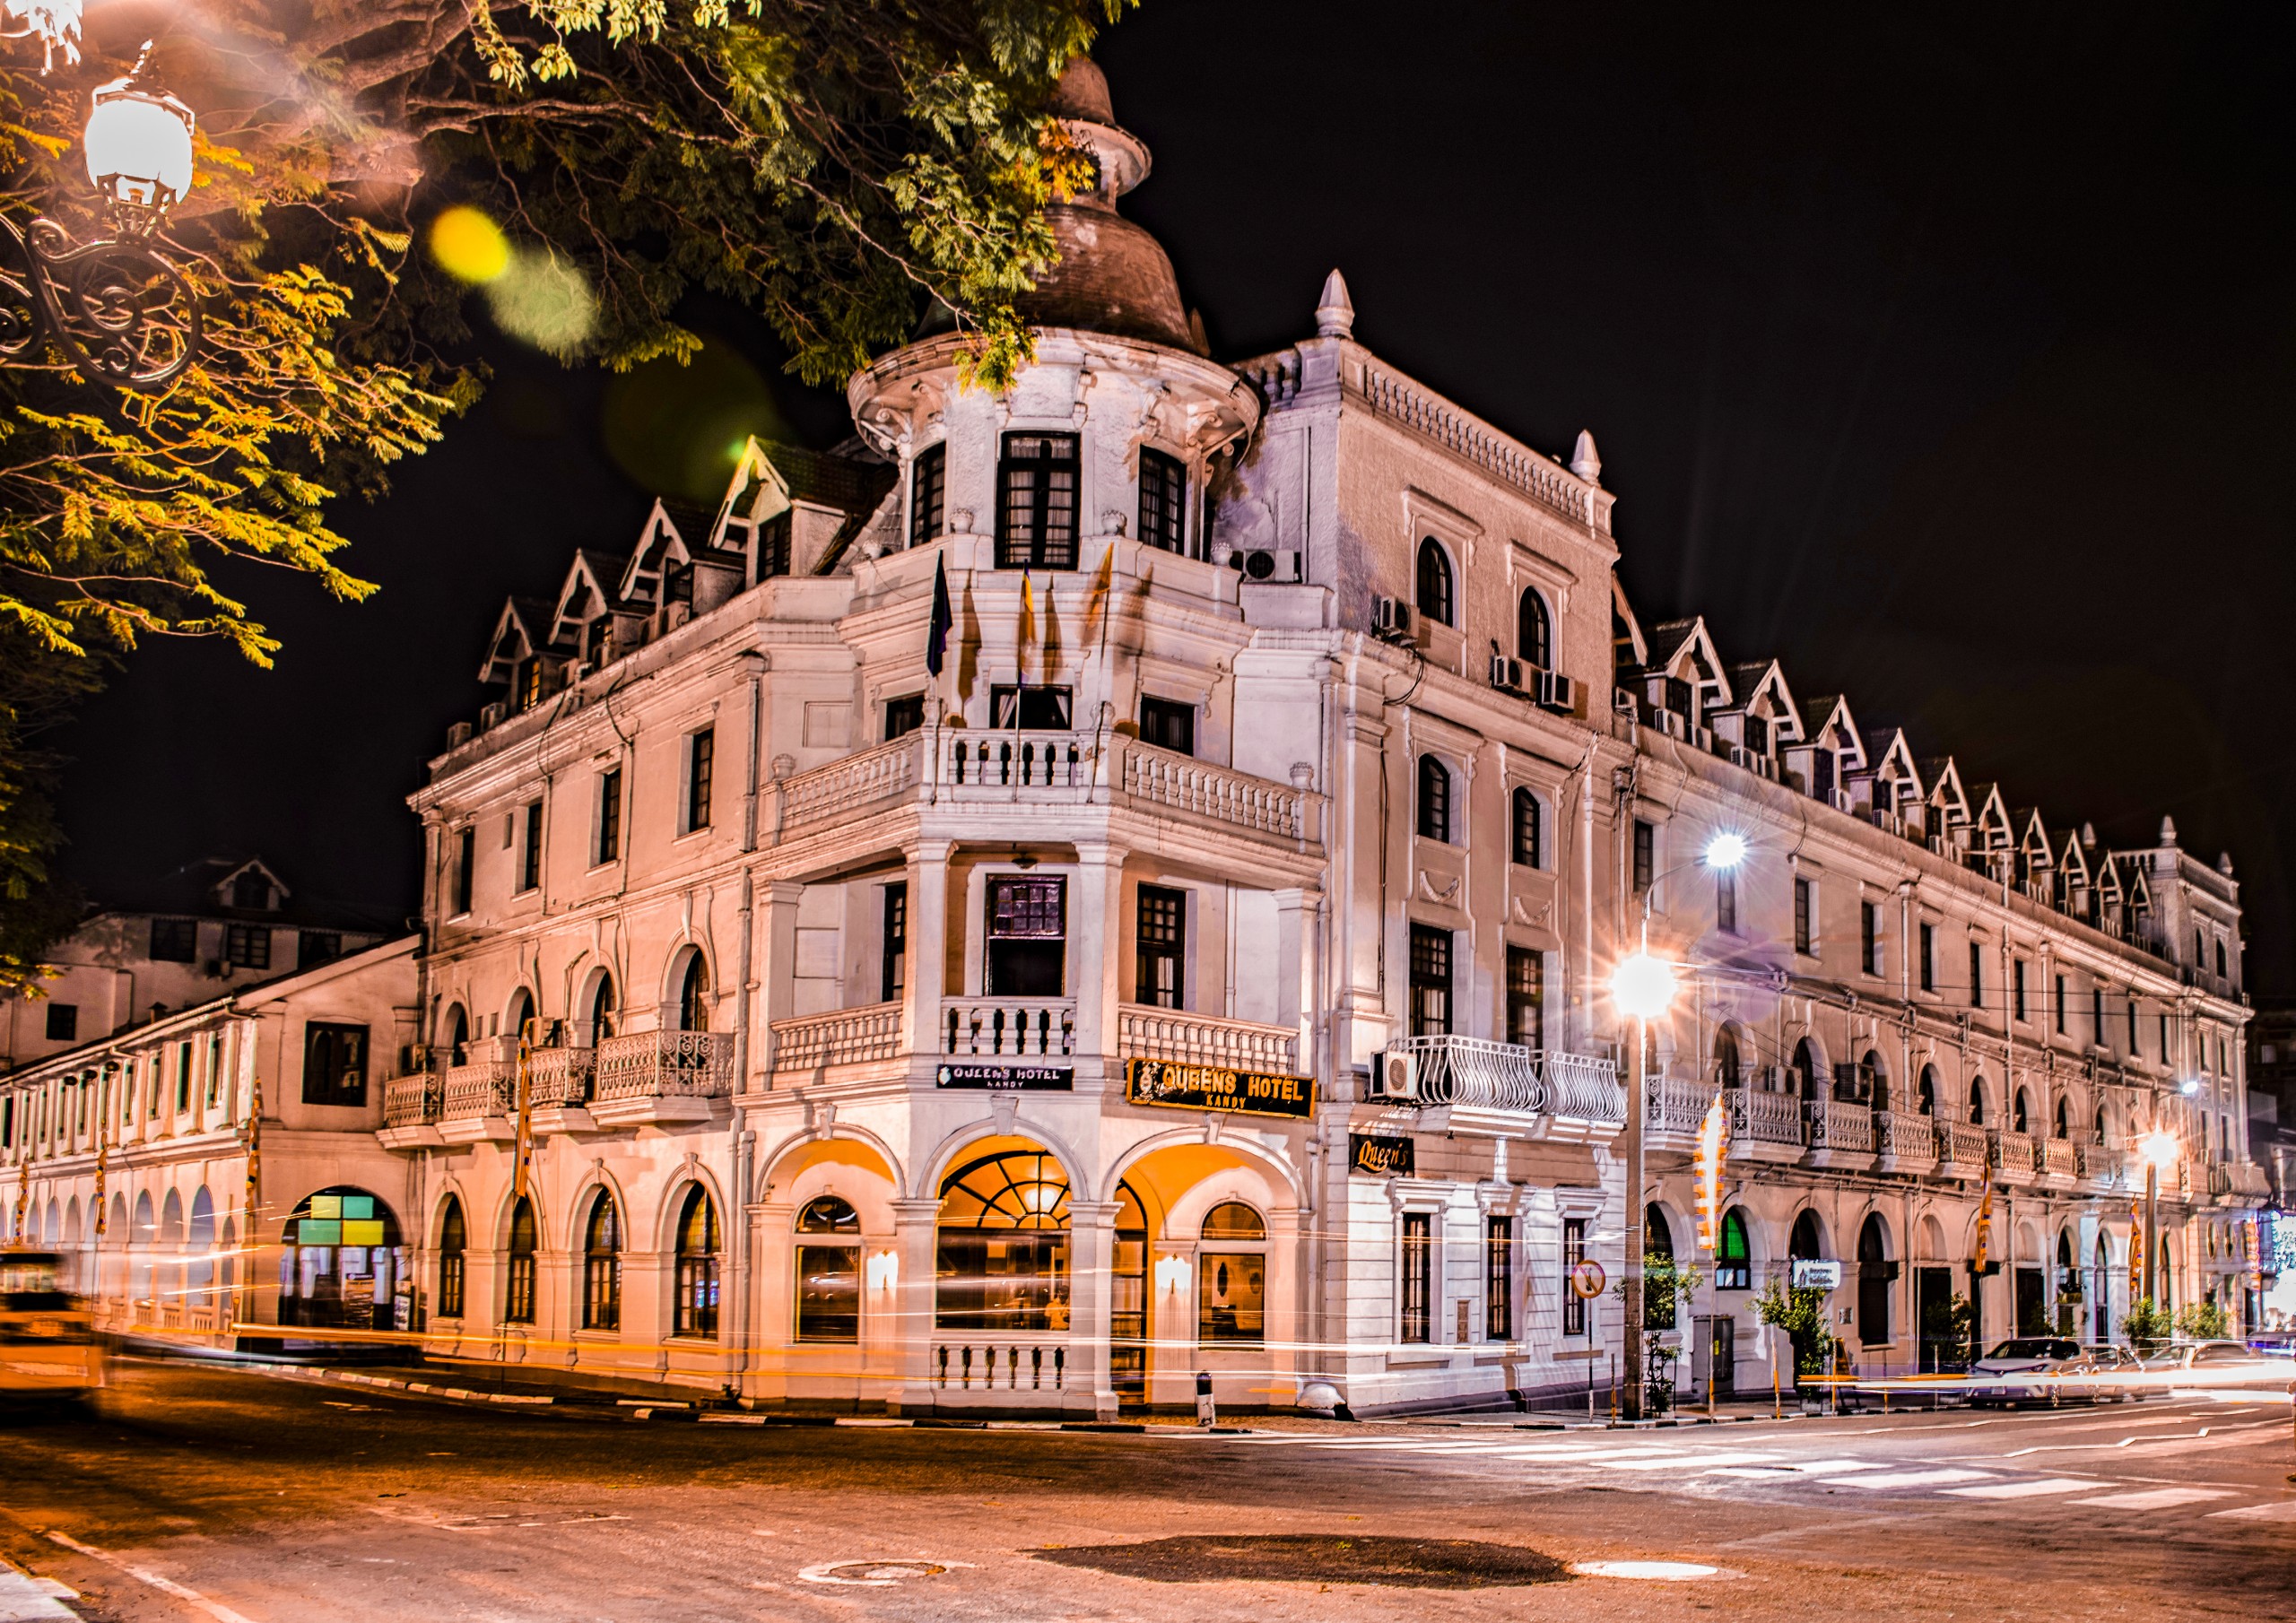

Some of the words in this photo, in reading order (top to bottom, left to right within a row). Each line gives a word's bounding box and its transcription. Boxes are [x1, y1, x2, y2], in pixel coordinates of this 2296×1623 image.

[953, 1067, 1011, 1079] QUEENS
[1016, 1069, 1060, 1080] HOTEL
[1162, 1067, 1237, 1094] QUEENS
[1248, 1076, 1304, 1101] HOTEL
[1206, 1095, 1247, 1109] KANDY
[1357, 1140, 1409, 1172] Queen's
